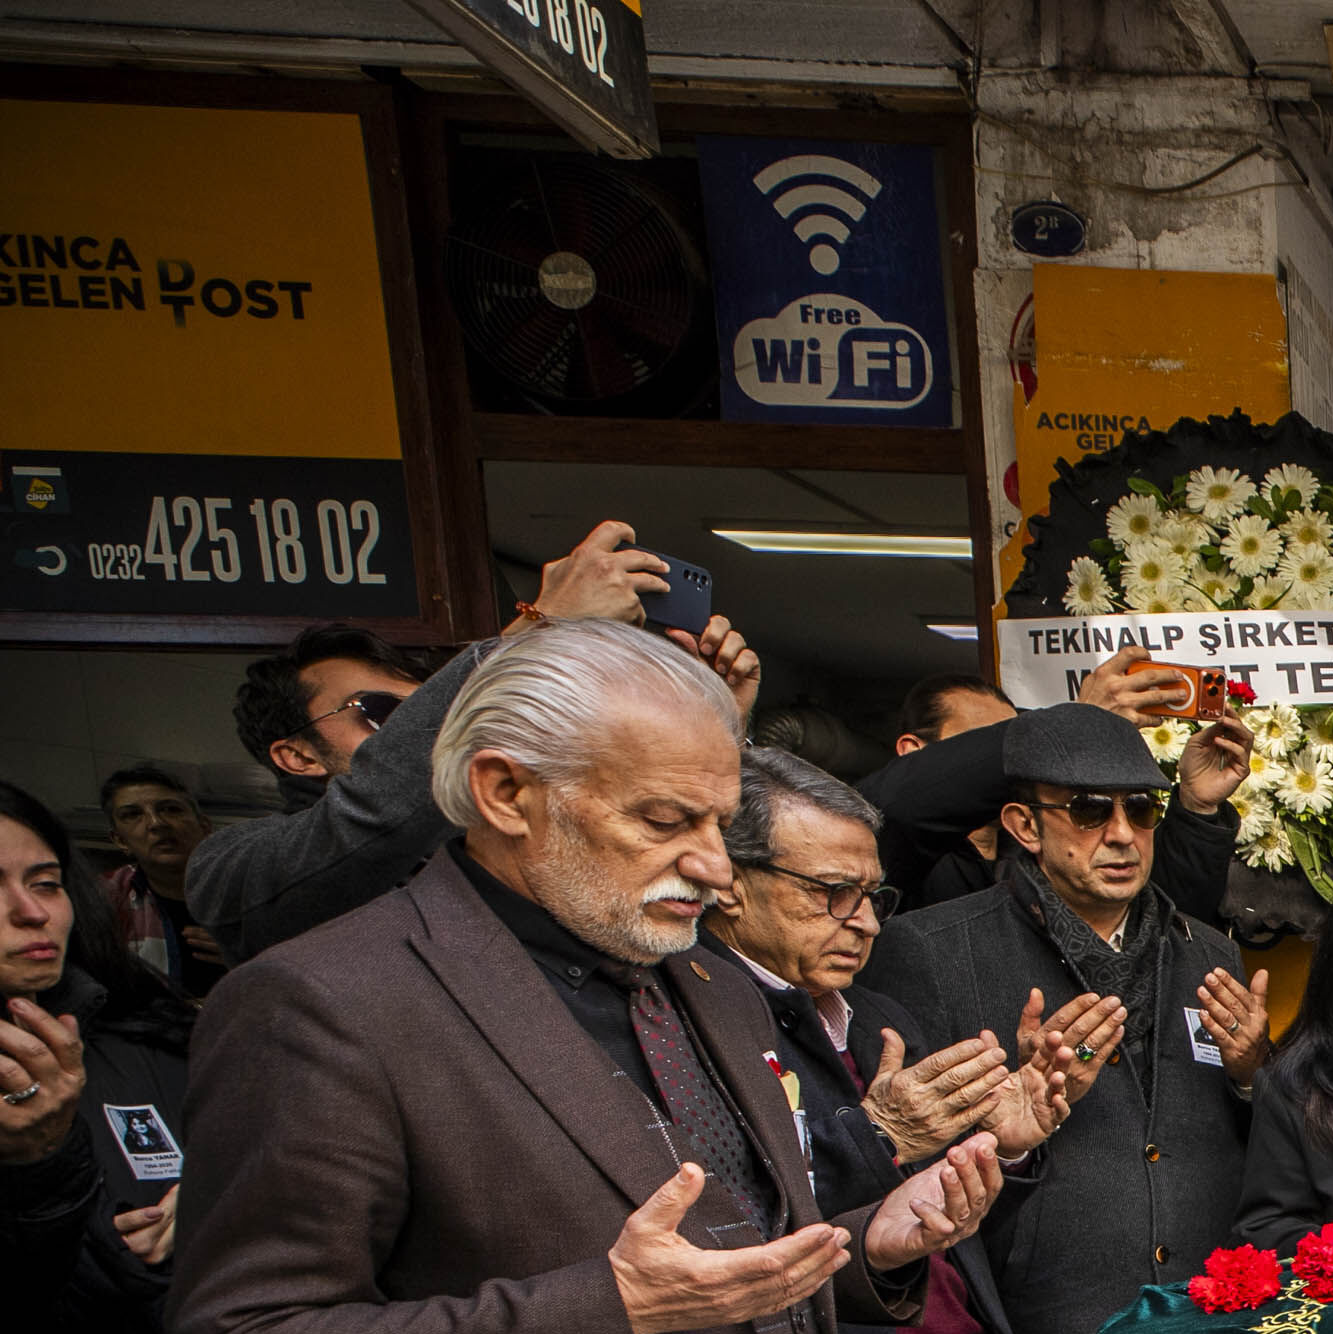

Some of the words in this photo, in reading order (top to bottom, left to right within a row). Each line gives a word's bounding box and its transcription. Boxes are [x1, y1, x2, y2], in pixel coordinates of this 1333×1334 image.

[800, 304, 861, 325] Free
[1036, 412, 1151, 433] ACIKINCA
[88, 543, 145, 580] 0232
[145, 496, 242, 582] 425
[250, 498, 307, 584] 18
[316, 499, 387, 584] 02
[1028, 621, 1184, 655] TEKİNALP
